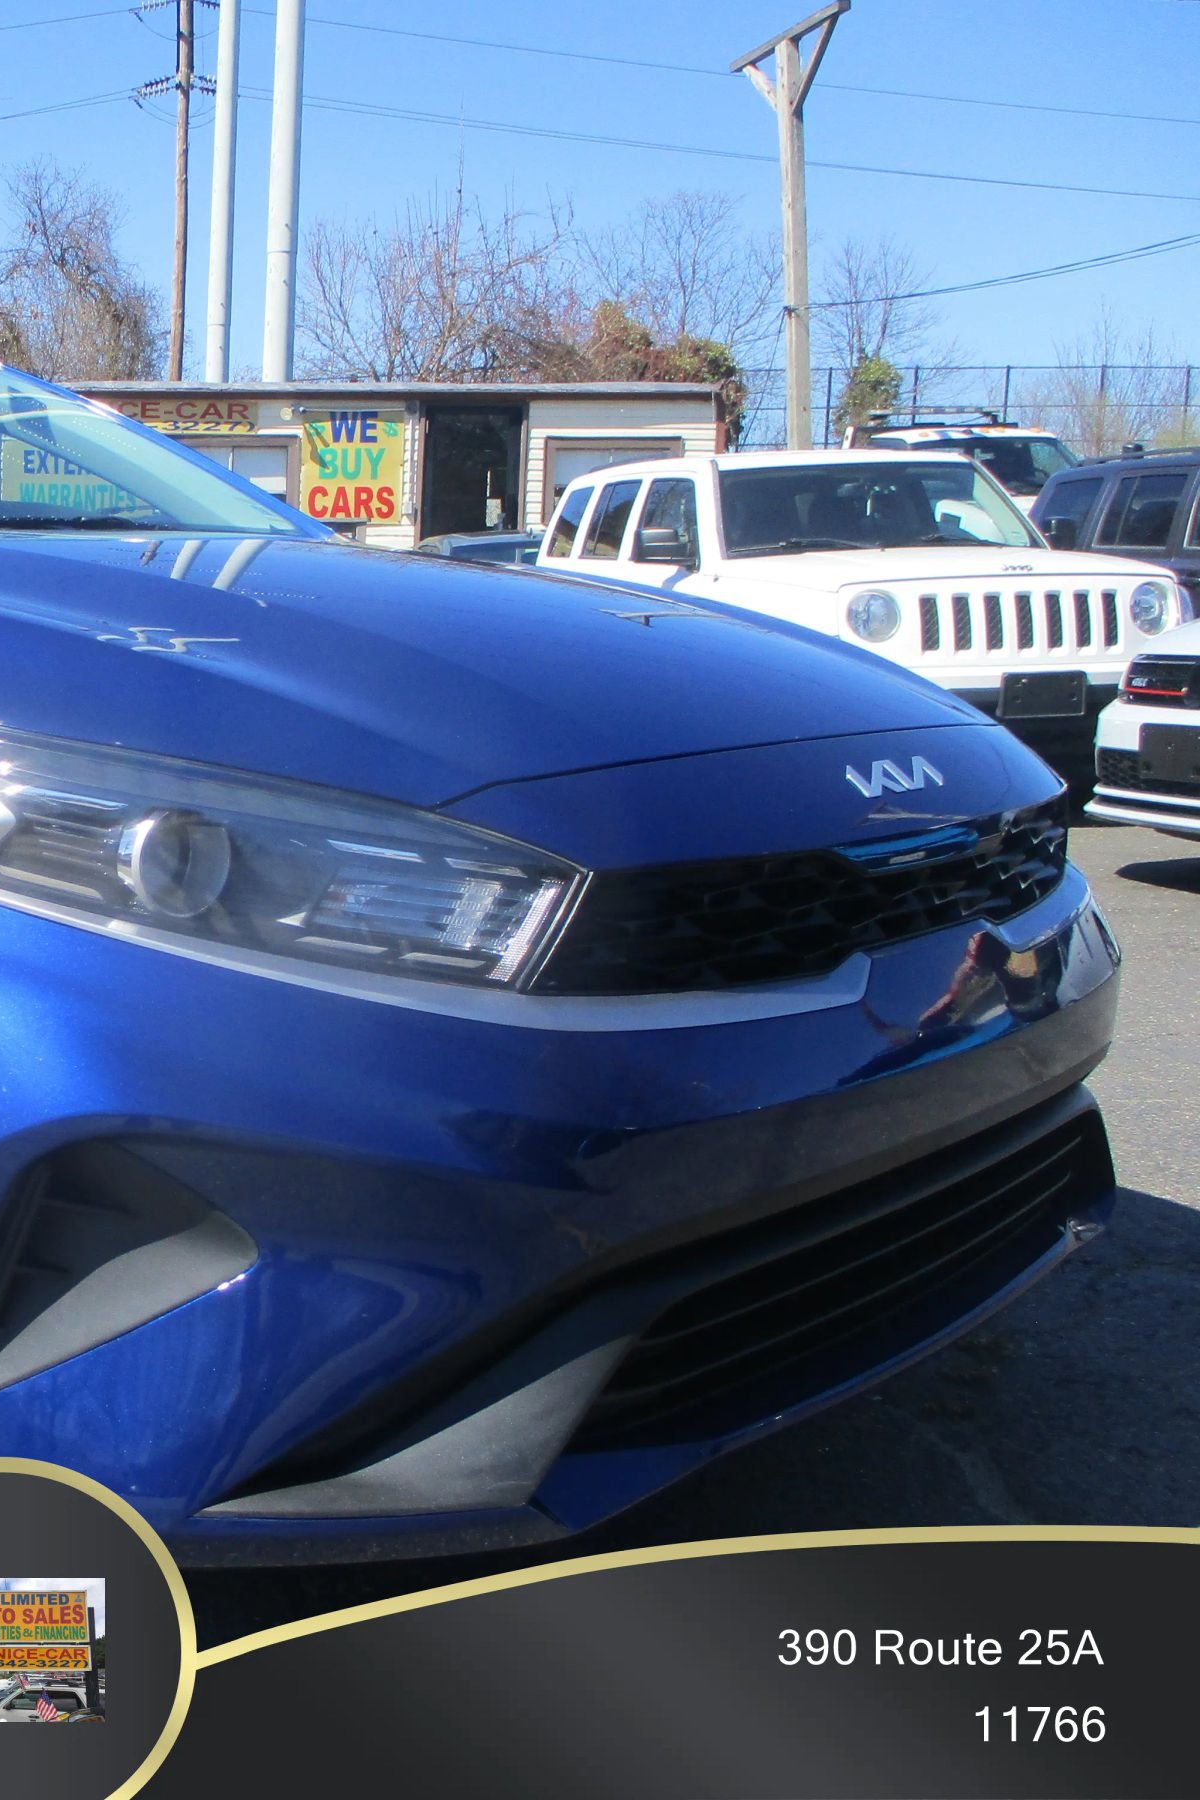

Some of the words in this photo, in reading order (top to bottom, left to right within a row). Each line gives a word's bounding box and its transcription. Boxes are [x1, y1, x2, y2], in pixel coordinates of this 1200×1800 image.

[117, 400, 249, 420] CE-CAR
[329, 410, 378, 443] WE
[318, 447, 386, 480] BUY
[308, 486, 395, 519] CARS
